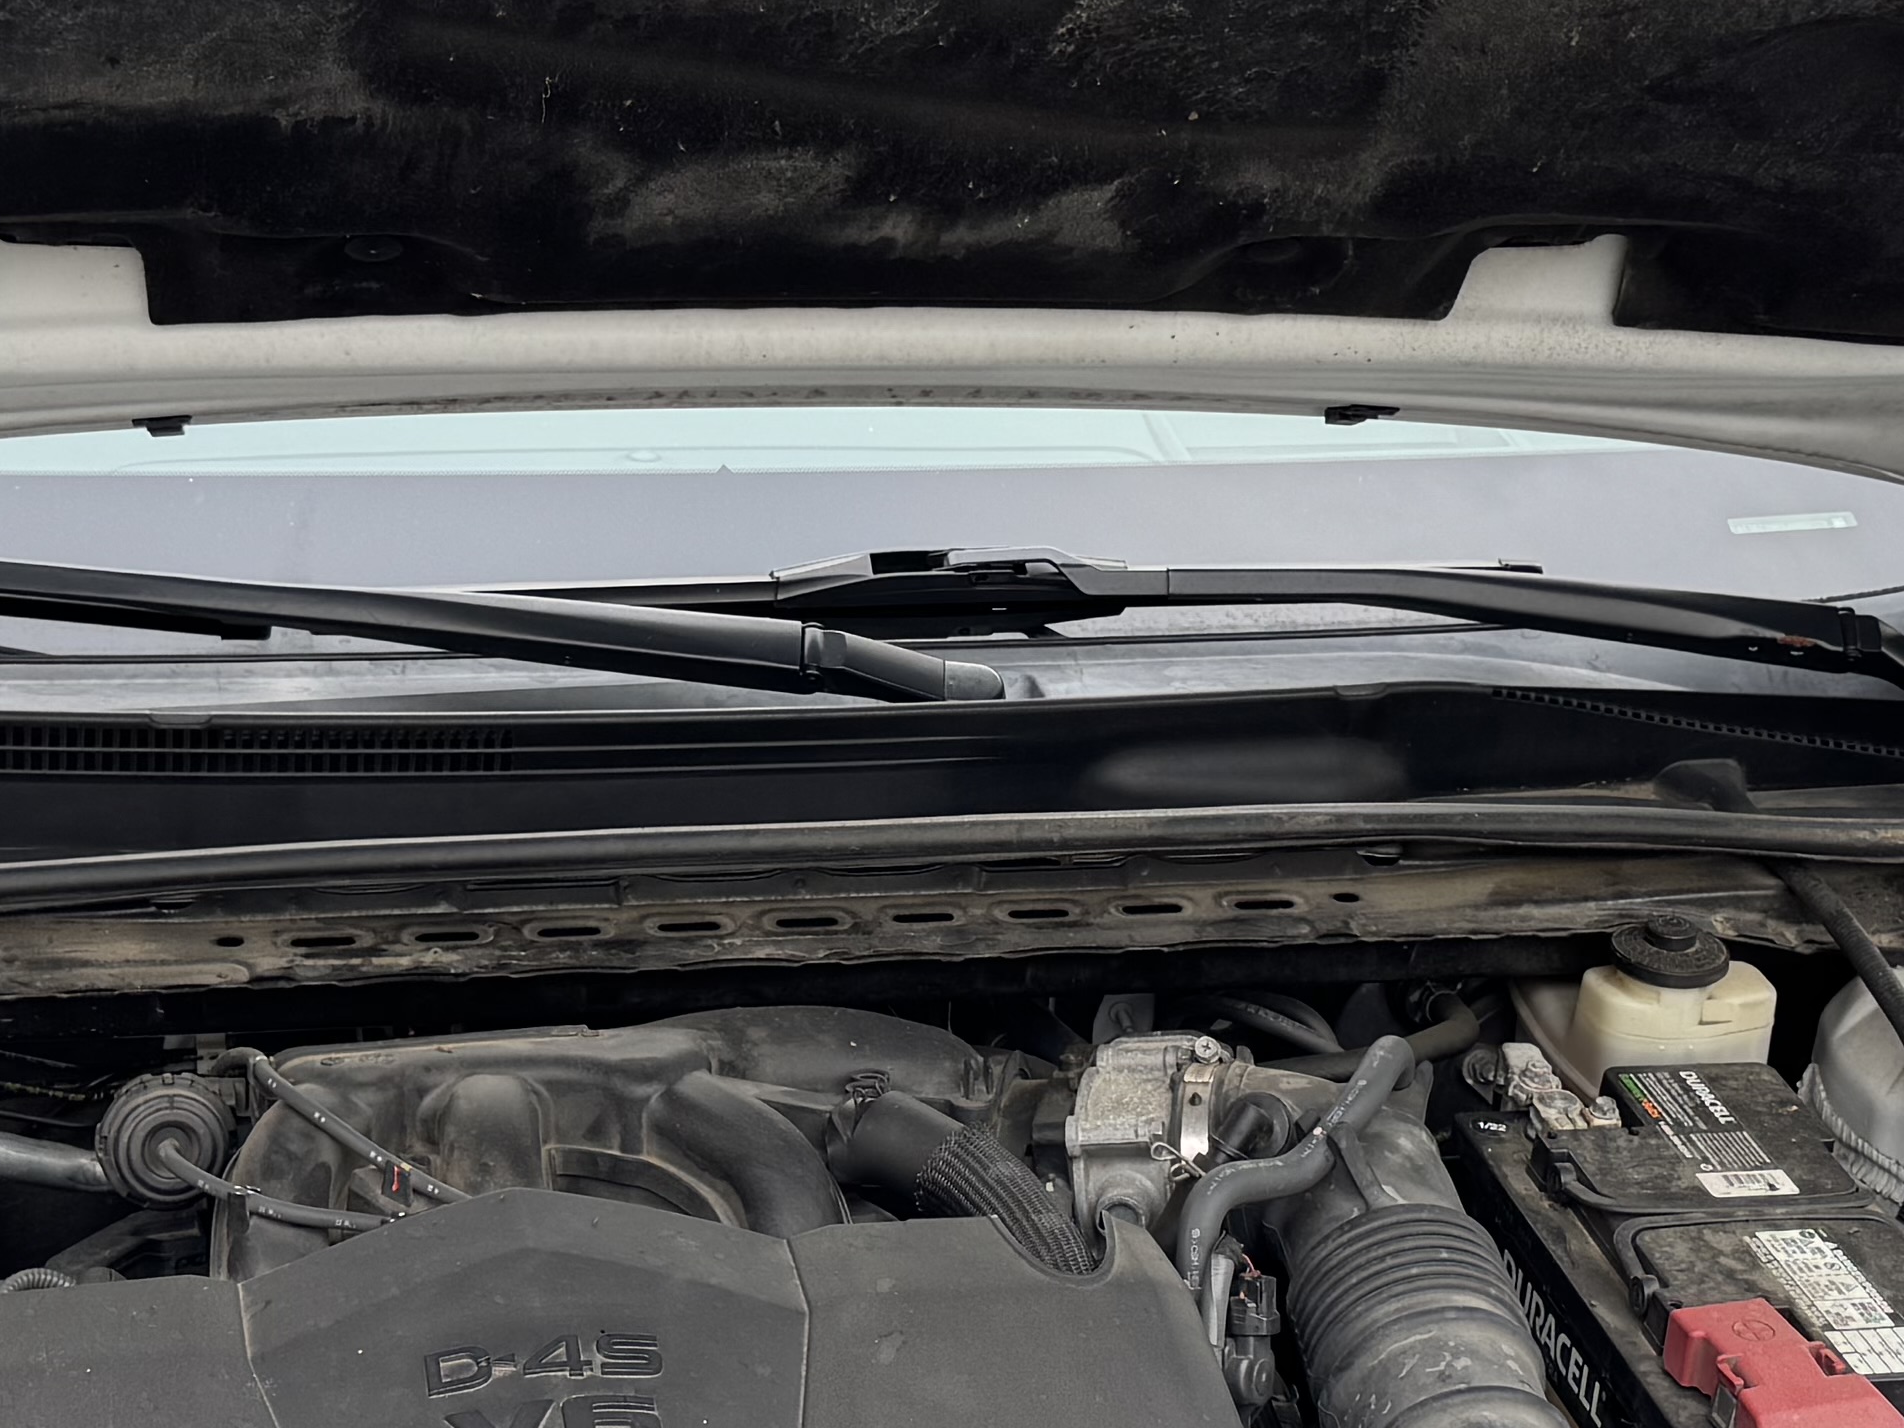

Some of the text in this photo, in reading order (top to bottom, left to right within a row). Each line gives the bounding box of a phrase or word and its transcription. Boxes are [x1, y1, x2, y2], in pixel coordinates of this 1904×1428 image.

[1477, 1121, 1507, 1132] 1/22
[1679, 1070, 1737, 1124] DURACELL
[424, 1331, 663, 1397] D-4S
[1503, 1249, 1602, 1428] DURACELL
